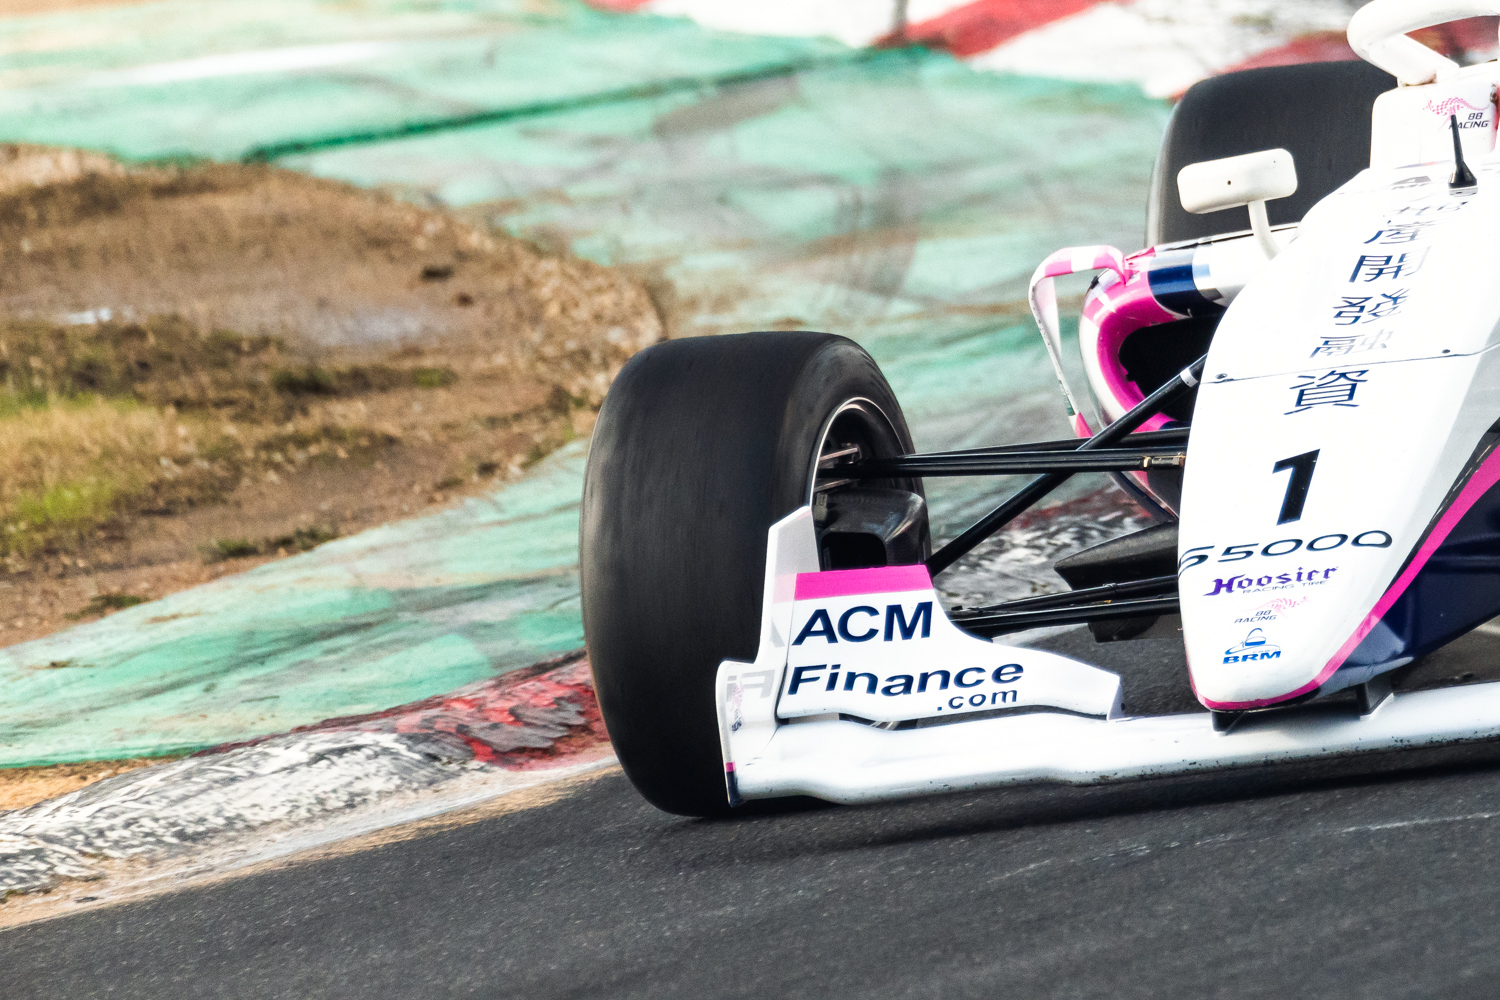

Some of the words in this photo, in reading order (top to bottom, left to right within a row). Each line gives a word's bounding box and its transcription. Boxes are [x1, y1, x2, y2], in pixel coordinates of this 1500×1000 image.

[1272, 449, 1321, 526] 1
[1178, 530, 1393, 578] S5000
[1202, 566, 1340, 597] Hoosier
[1243, 584, 1295, 594] RACING
[791, 601, 933, 646] ACM
[1234, 615, 1278, 624] RACING
[1222, 651, 1281, 664] BRM
[788, 663, 1024, 696] Finance
[937, 690, 1018, 711] .com
